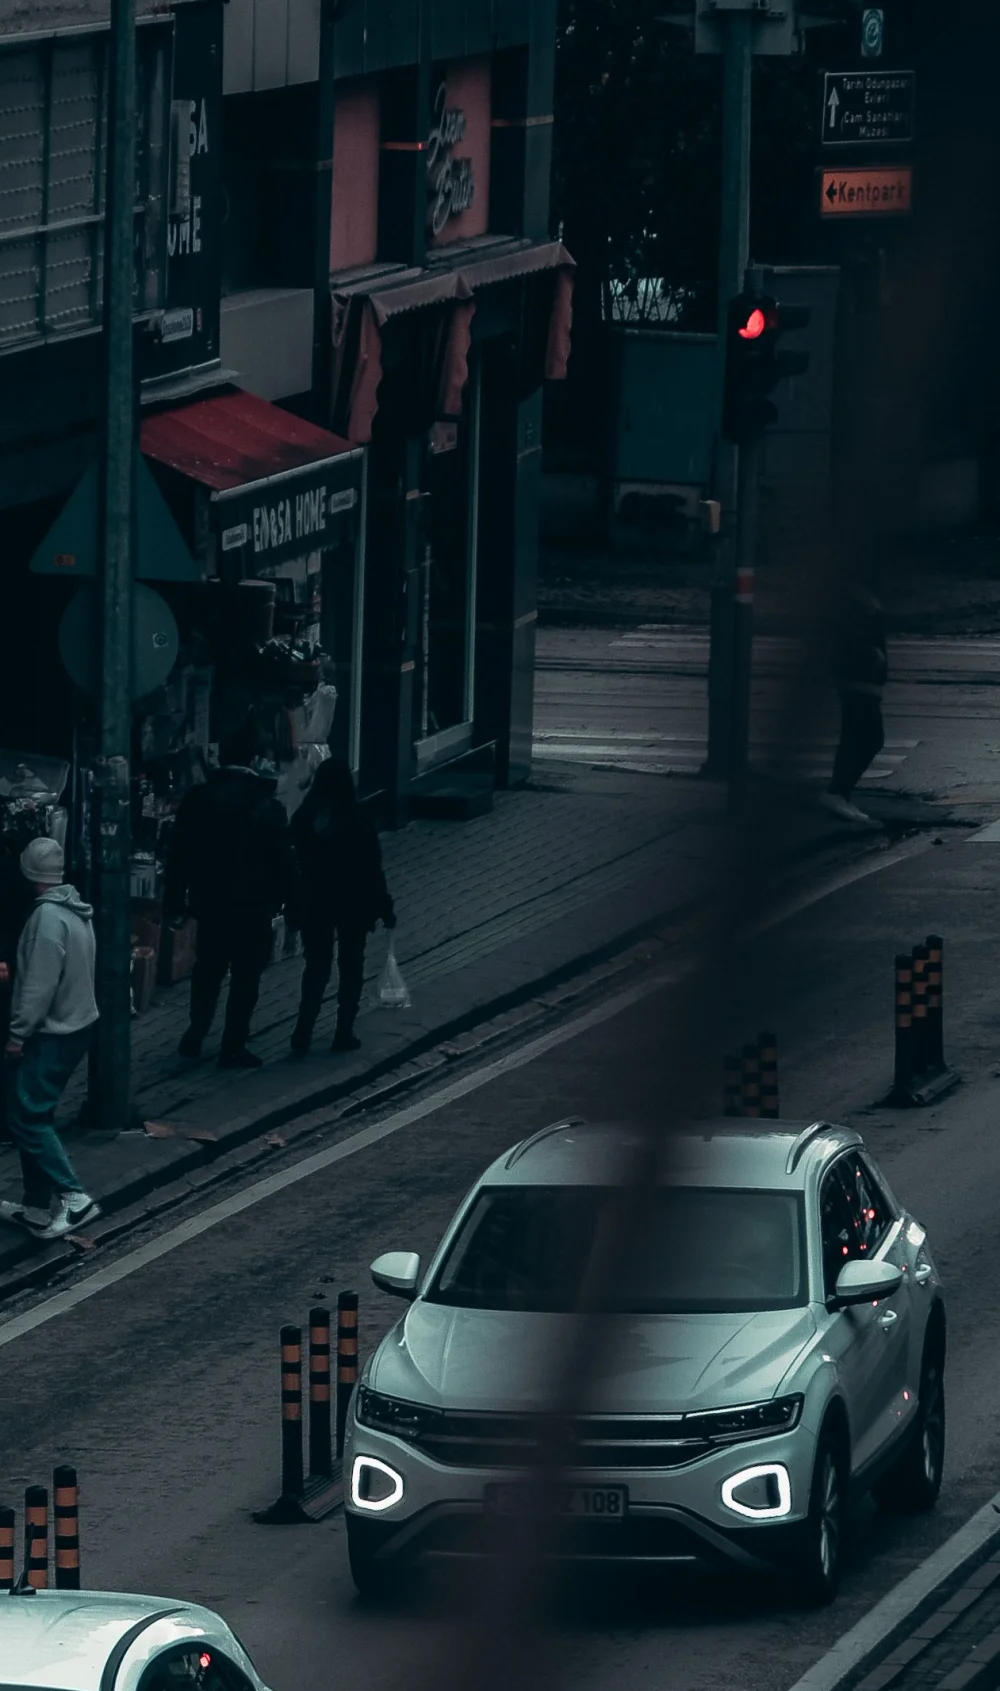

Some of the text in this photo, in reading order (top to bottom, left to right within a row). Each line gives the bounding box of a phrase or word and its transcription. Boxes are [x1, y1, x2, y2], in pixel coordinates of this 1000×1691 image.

[838, 180, 906, 206] Kentpark
[295, 486, 327, 538] HOME
[582, 1491, 620, 1514] 108
